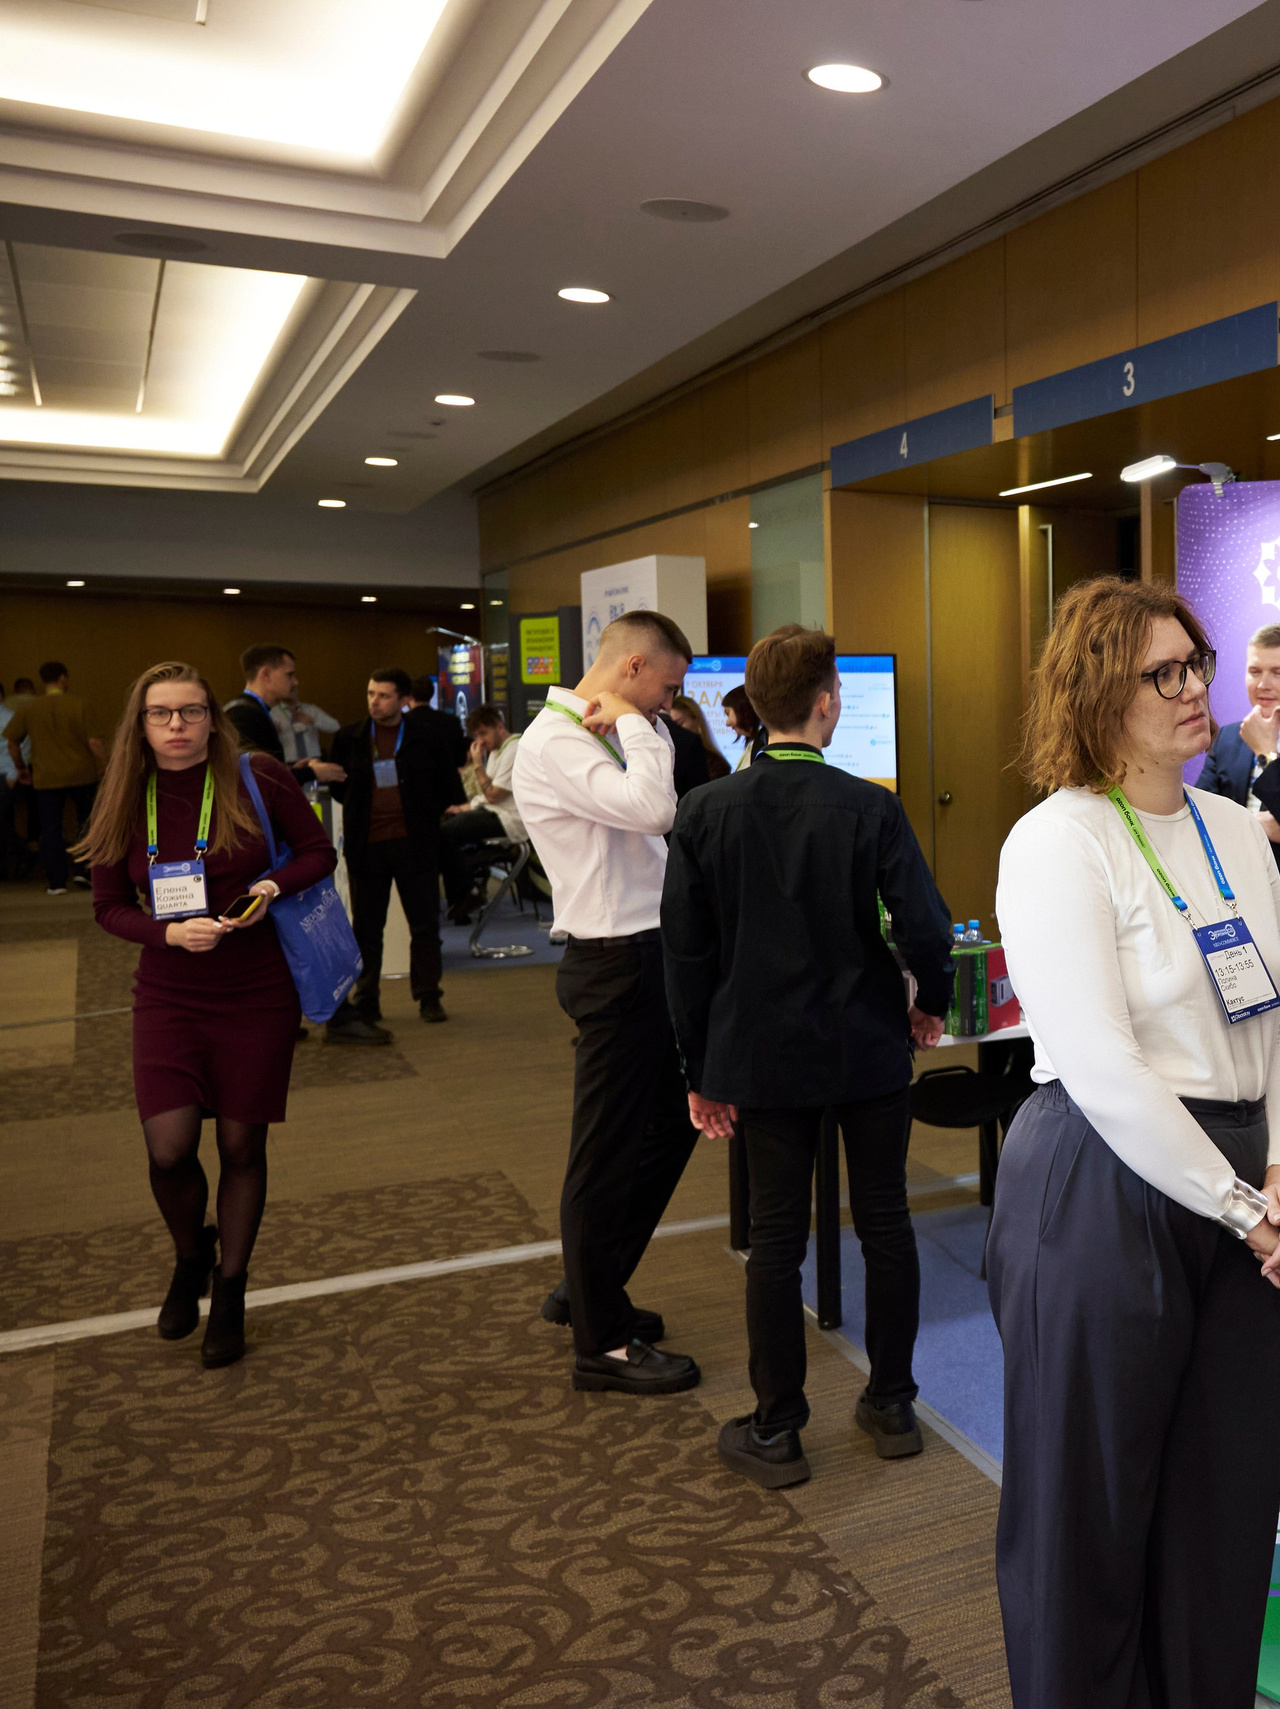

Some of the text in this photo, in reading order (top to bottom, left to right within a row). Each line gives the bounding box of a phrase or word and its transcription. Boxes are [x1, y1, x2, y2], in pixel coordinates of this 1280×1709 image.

[1123, 361, 1135, 397] 3
[900, 432, 908, 459] 4
[1124, 810, 1135, 827] банк
[155, 886, 187, 895] Елена
[156, 893, 194, 903] Кожина
[157, 901, 188, 910] QUARTA
[1224, 949, 1242, 961] День
[1215, 959, 1254, 977] 13:15-13:55
[1226, 996, 1245, 1005] Кактус
